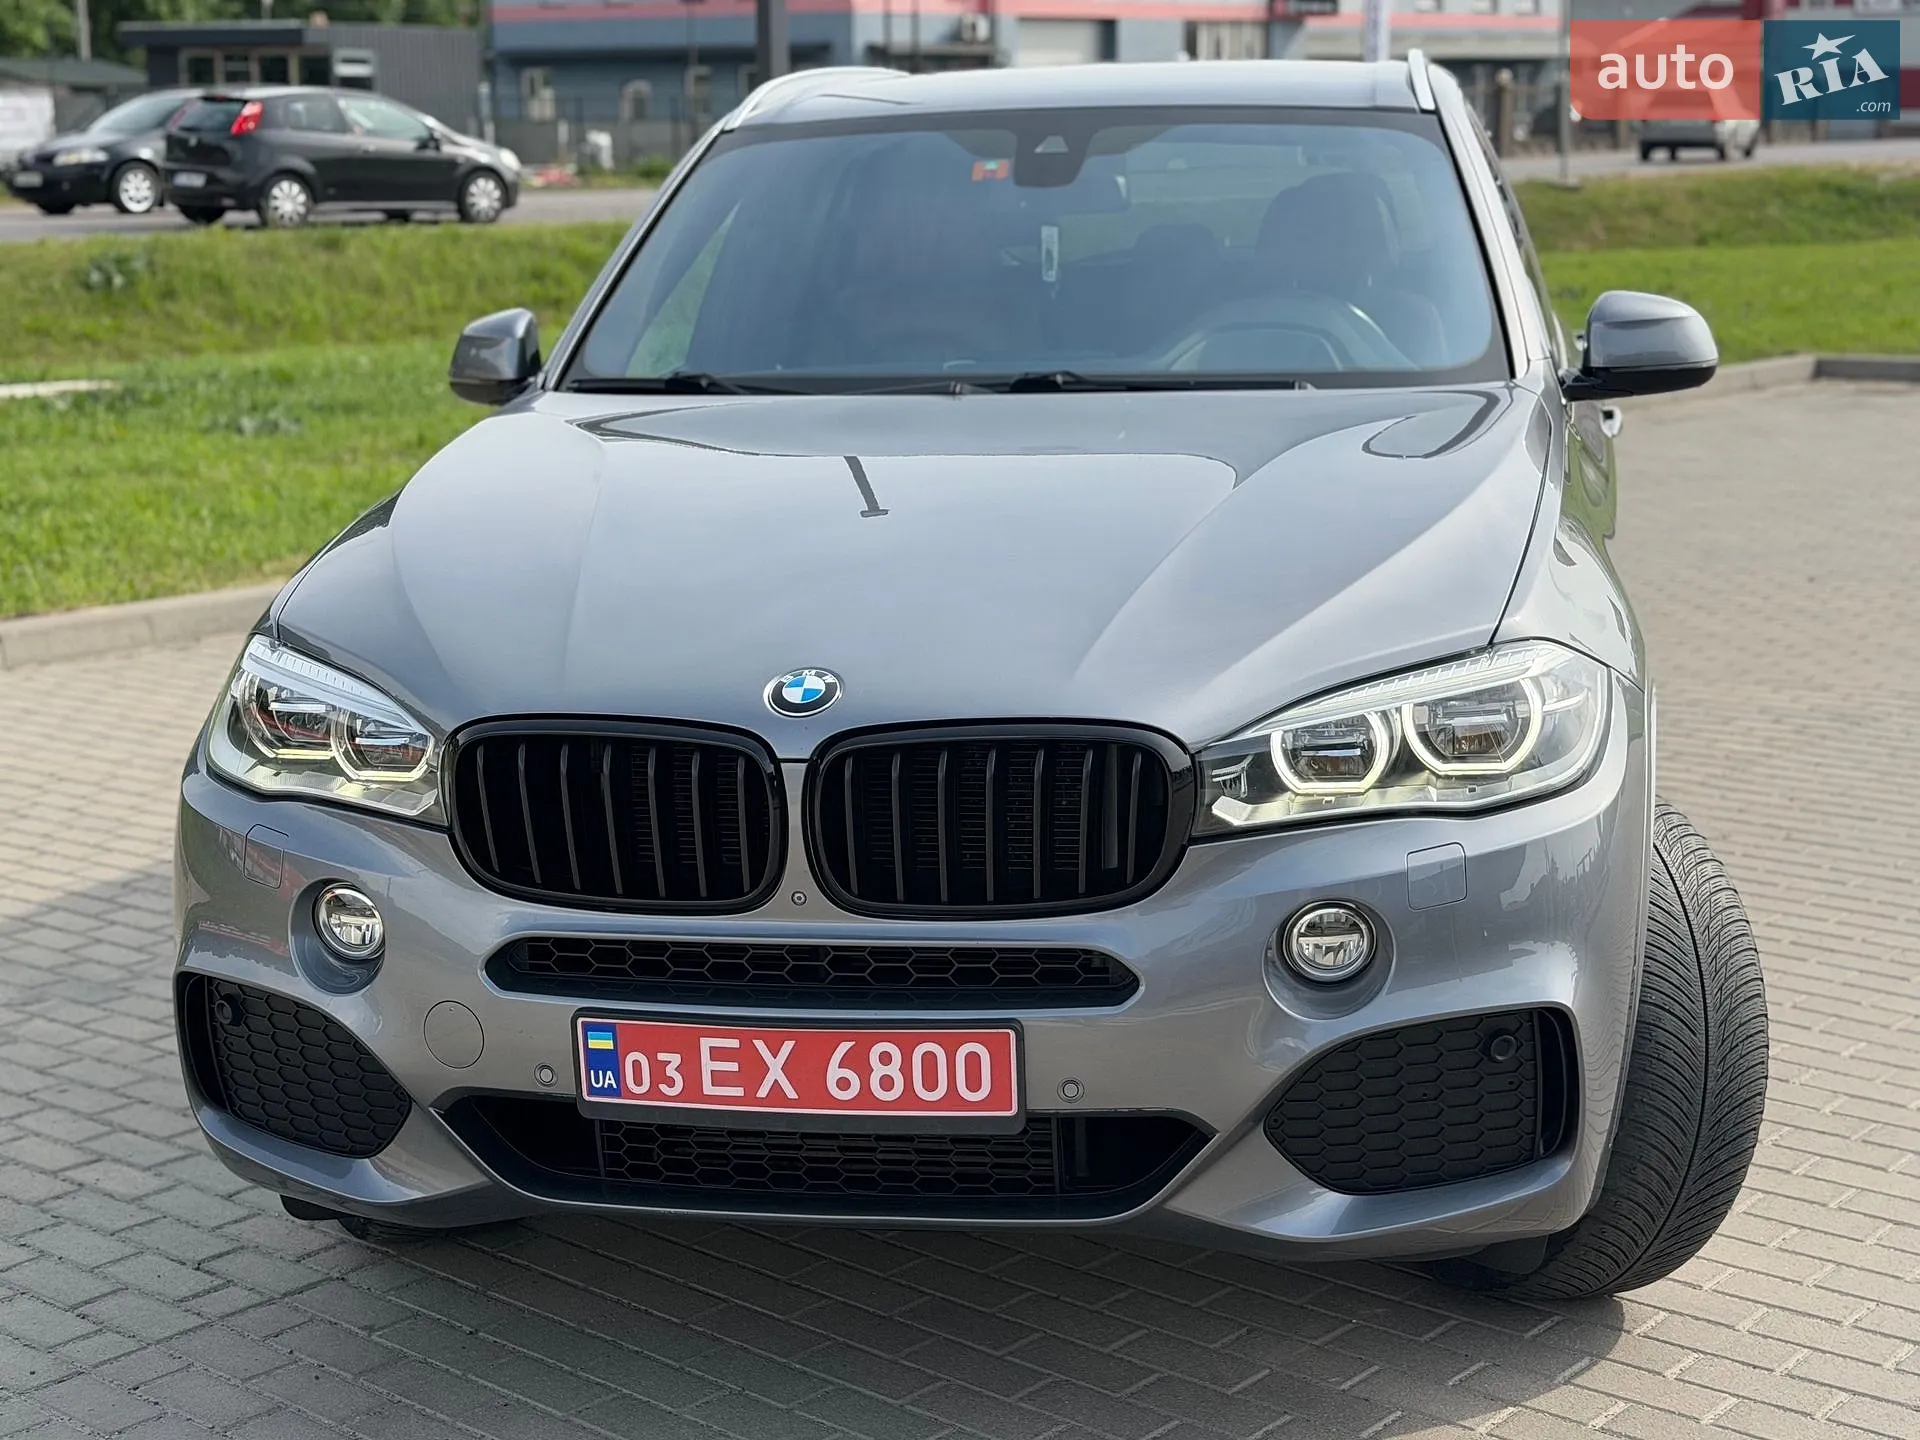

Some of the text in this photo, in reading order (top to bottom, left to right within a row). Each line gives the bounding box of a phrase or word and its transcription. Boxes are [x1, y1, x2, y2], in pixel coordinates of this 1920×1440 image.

[780, 669, 836, 683] BMW
[590, 1069, 617, 1088] UA
[624, 1037, 991, 1102] 03 EX 6800
